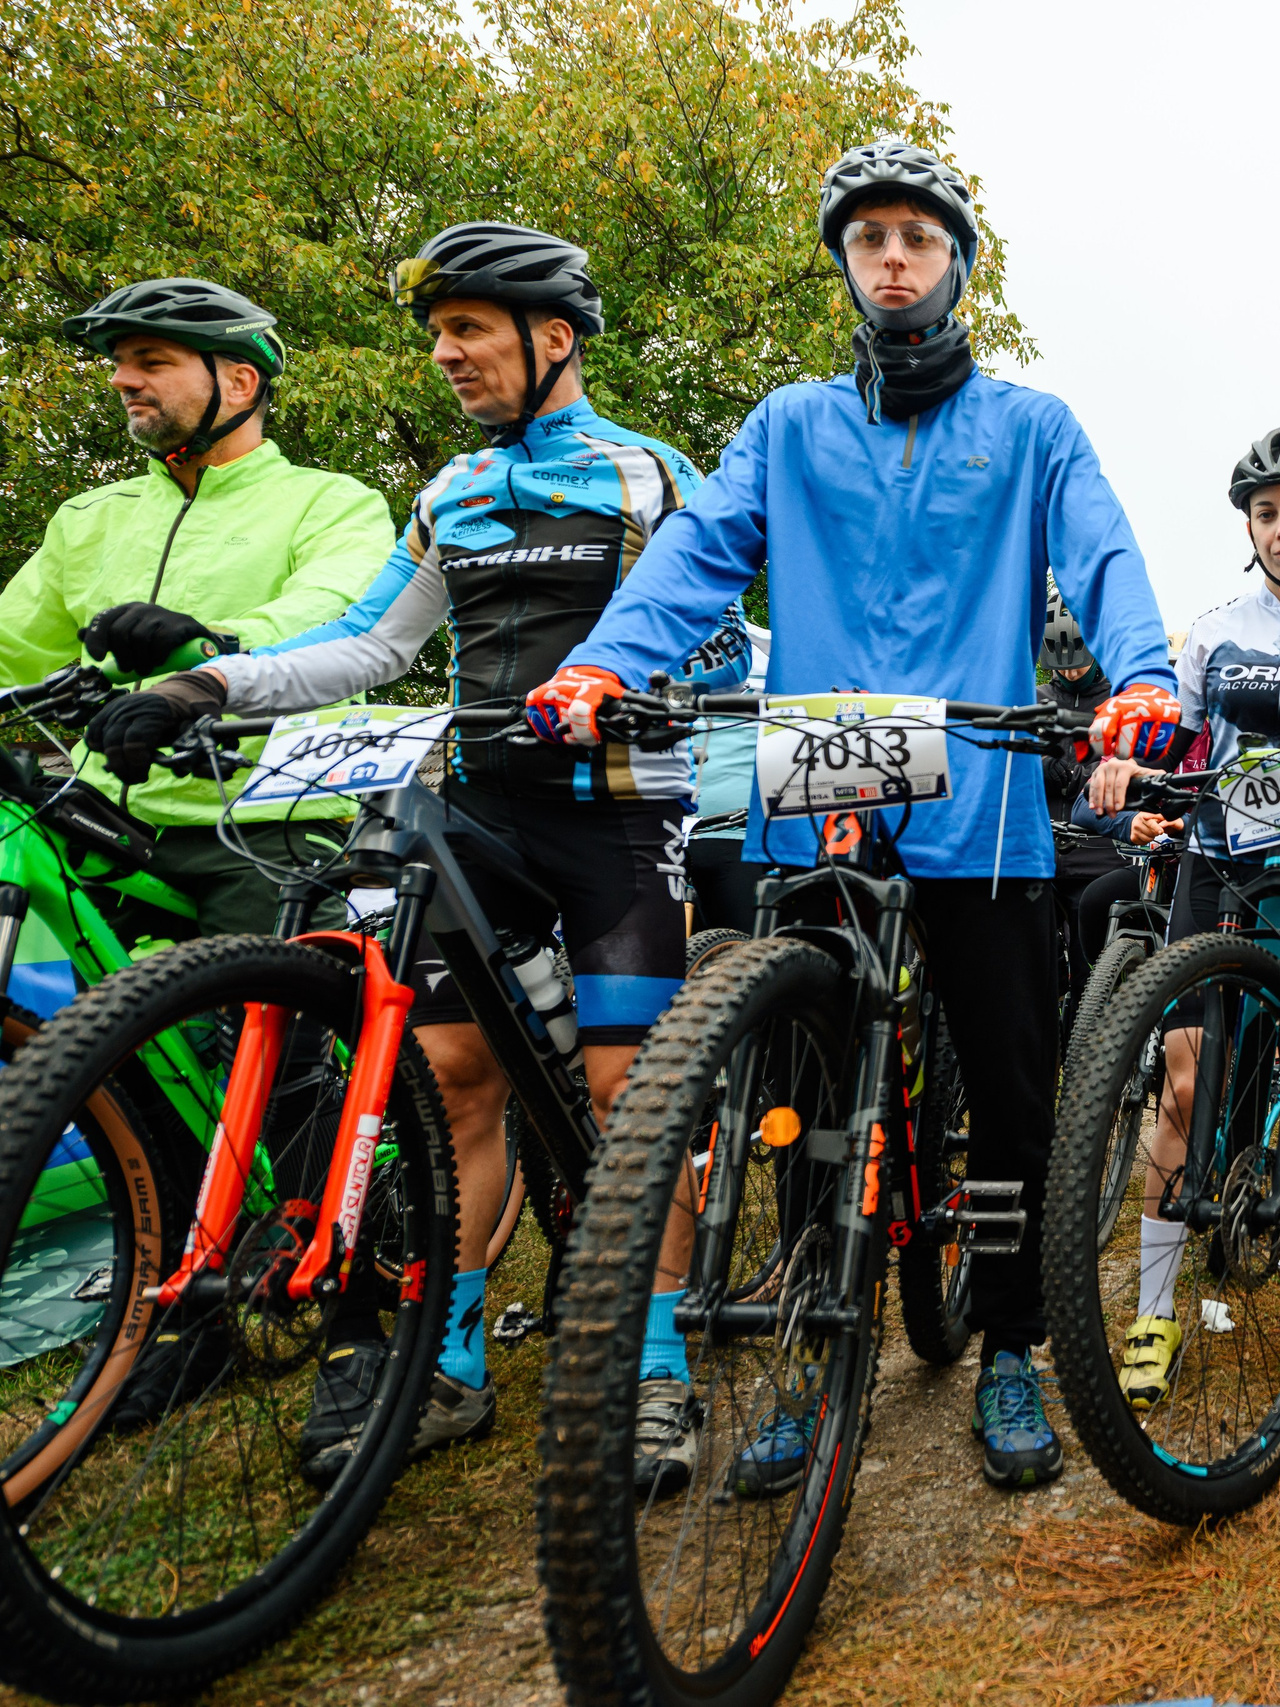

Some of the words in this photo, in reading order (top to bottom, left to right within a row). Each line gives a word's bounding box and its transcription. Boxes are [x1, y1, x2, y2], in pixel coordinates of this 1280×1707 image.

[226, 321, 269, 334] ROCKRIDER
[251, 332, 277, 363] LIMBA
[532, 470, 592, 486] connex
[455, 516, 484, 529] POWER
[458, 522, 492, 536] FITNESS
[1217, 681, 1278, 691] FACTORY
[792, 728, 911, 771] 4013
[351, 765, 372, 779] 21
[71, 813, 119, 840] MERIDA
[1251, 826, 1272, 835] CURSA
[400, 1052, 449, 1216] CHWALBE
[374, 1147, 397, 1162] LIMBA
[345, 1140, 372, 1211] SUNTOUR
[133, 1176, 152, 1234] SAM
[124, 1243, 152, 1341] SMART
